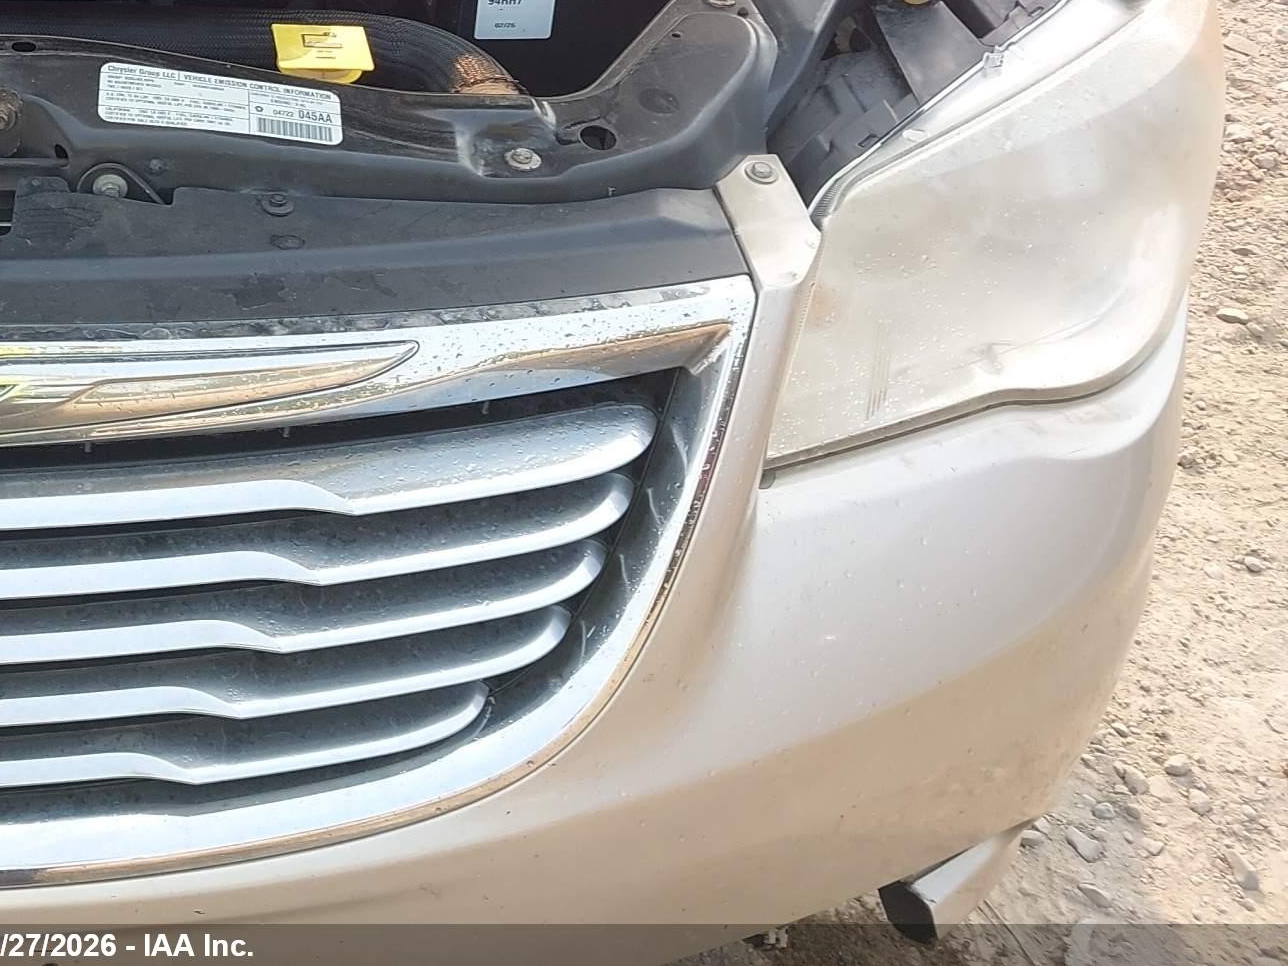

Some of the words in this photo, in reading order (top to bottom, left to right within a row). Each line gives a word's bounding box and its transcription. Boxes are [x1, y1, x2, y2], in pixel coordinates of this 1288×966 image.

[107, 65, 137, 75] Chrysler
[139, 68, 160, 78] Group
[162, 71, 177, 79] LLC
[183, 74, 213, 84] VEHICLE
[214, 78, 248, 88] EMISSION
[249, 83, 281, 93] CONTROL
[283, 88, 332, 100] INFORMATION
